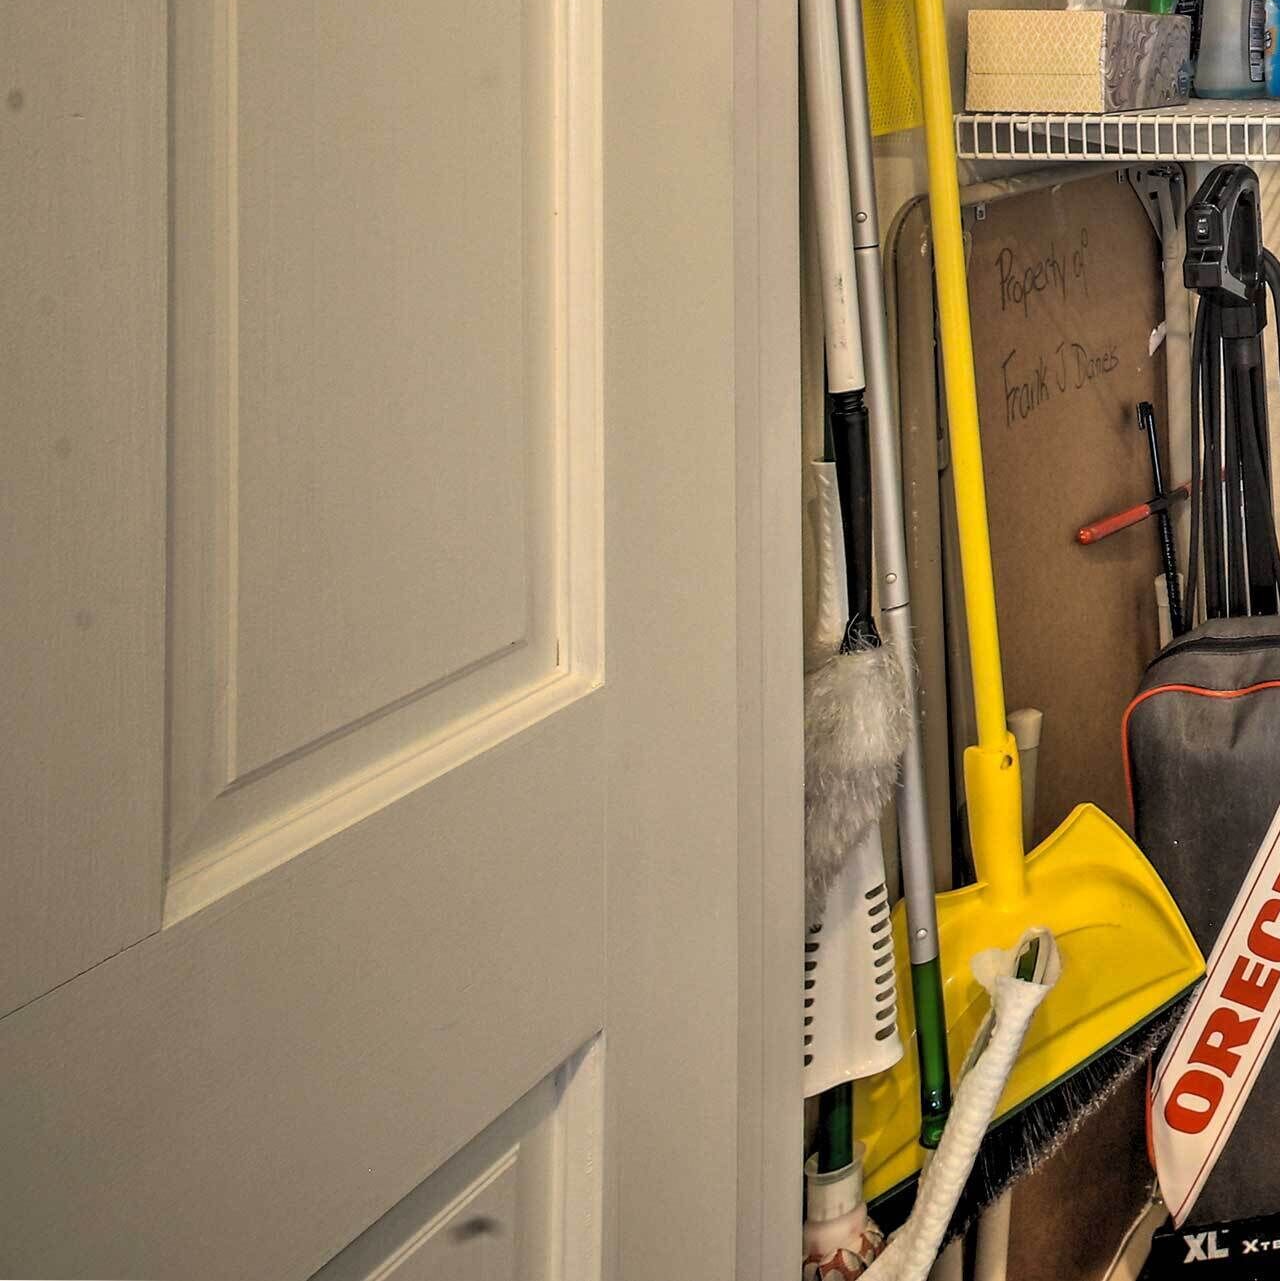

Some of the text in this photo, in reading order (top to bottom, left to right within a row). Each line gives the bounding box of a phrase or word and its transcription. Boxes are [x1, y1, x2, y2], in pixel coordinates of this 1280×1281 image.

[995, 227, 1089, 318] Property of
[1002, 348, 1050, 428] Frank
[1183, 1232, 1230, 1264] XL
